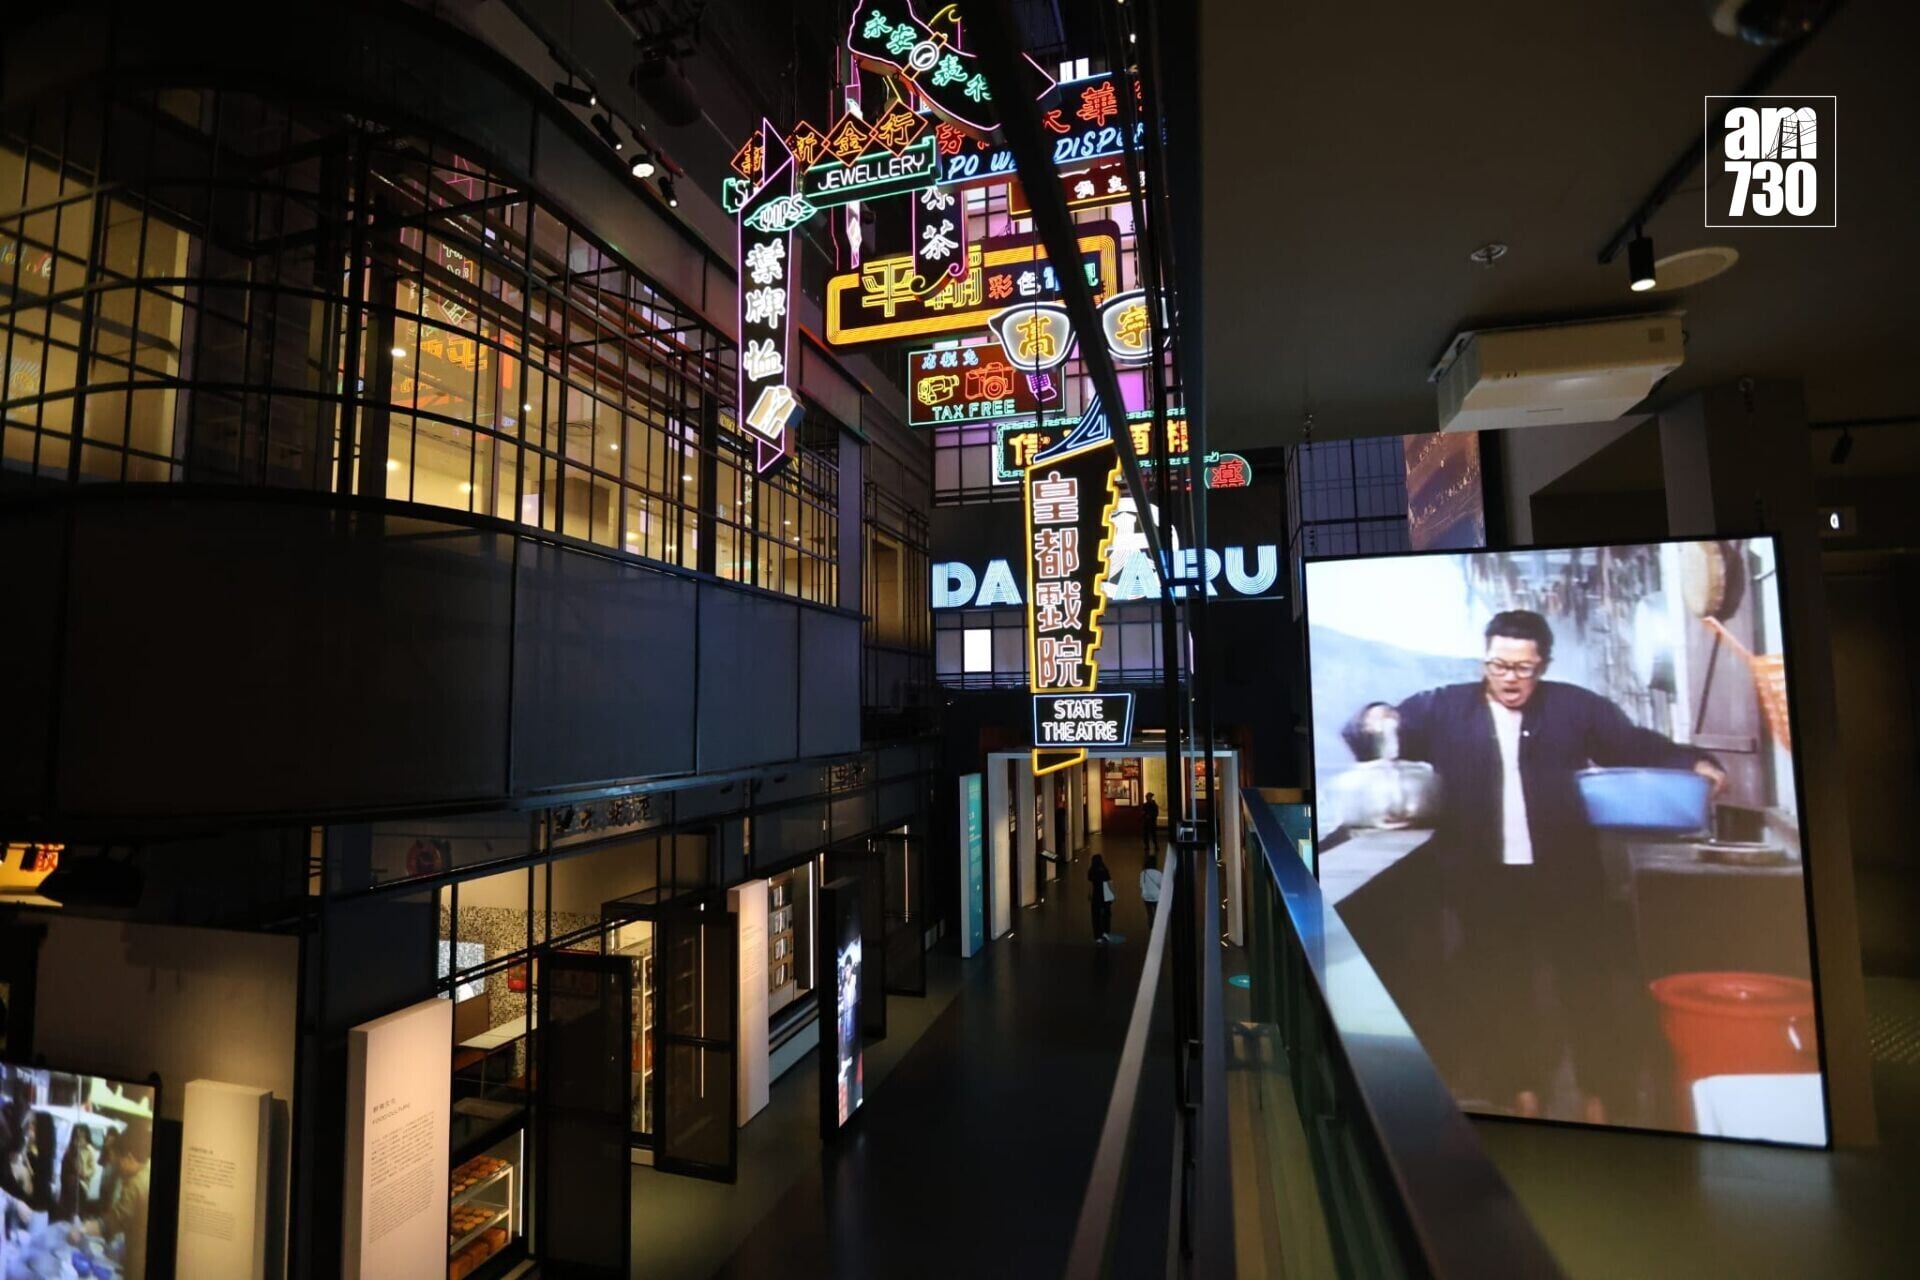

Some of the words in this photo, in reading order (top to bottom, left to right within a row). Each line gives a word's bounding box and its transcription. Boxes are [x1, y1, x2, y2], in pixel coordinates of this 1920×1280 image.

[817, 151, 926, 191] JEWELLERY
[947, 153, 980, 181] PO
[932, 402, 965, 421] TAX
[968, 398, 1016, 419] FREE
[1053, 698, 1104, 720] STATE
[1042, 720, 1119, 743] THEATRE
